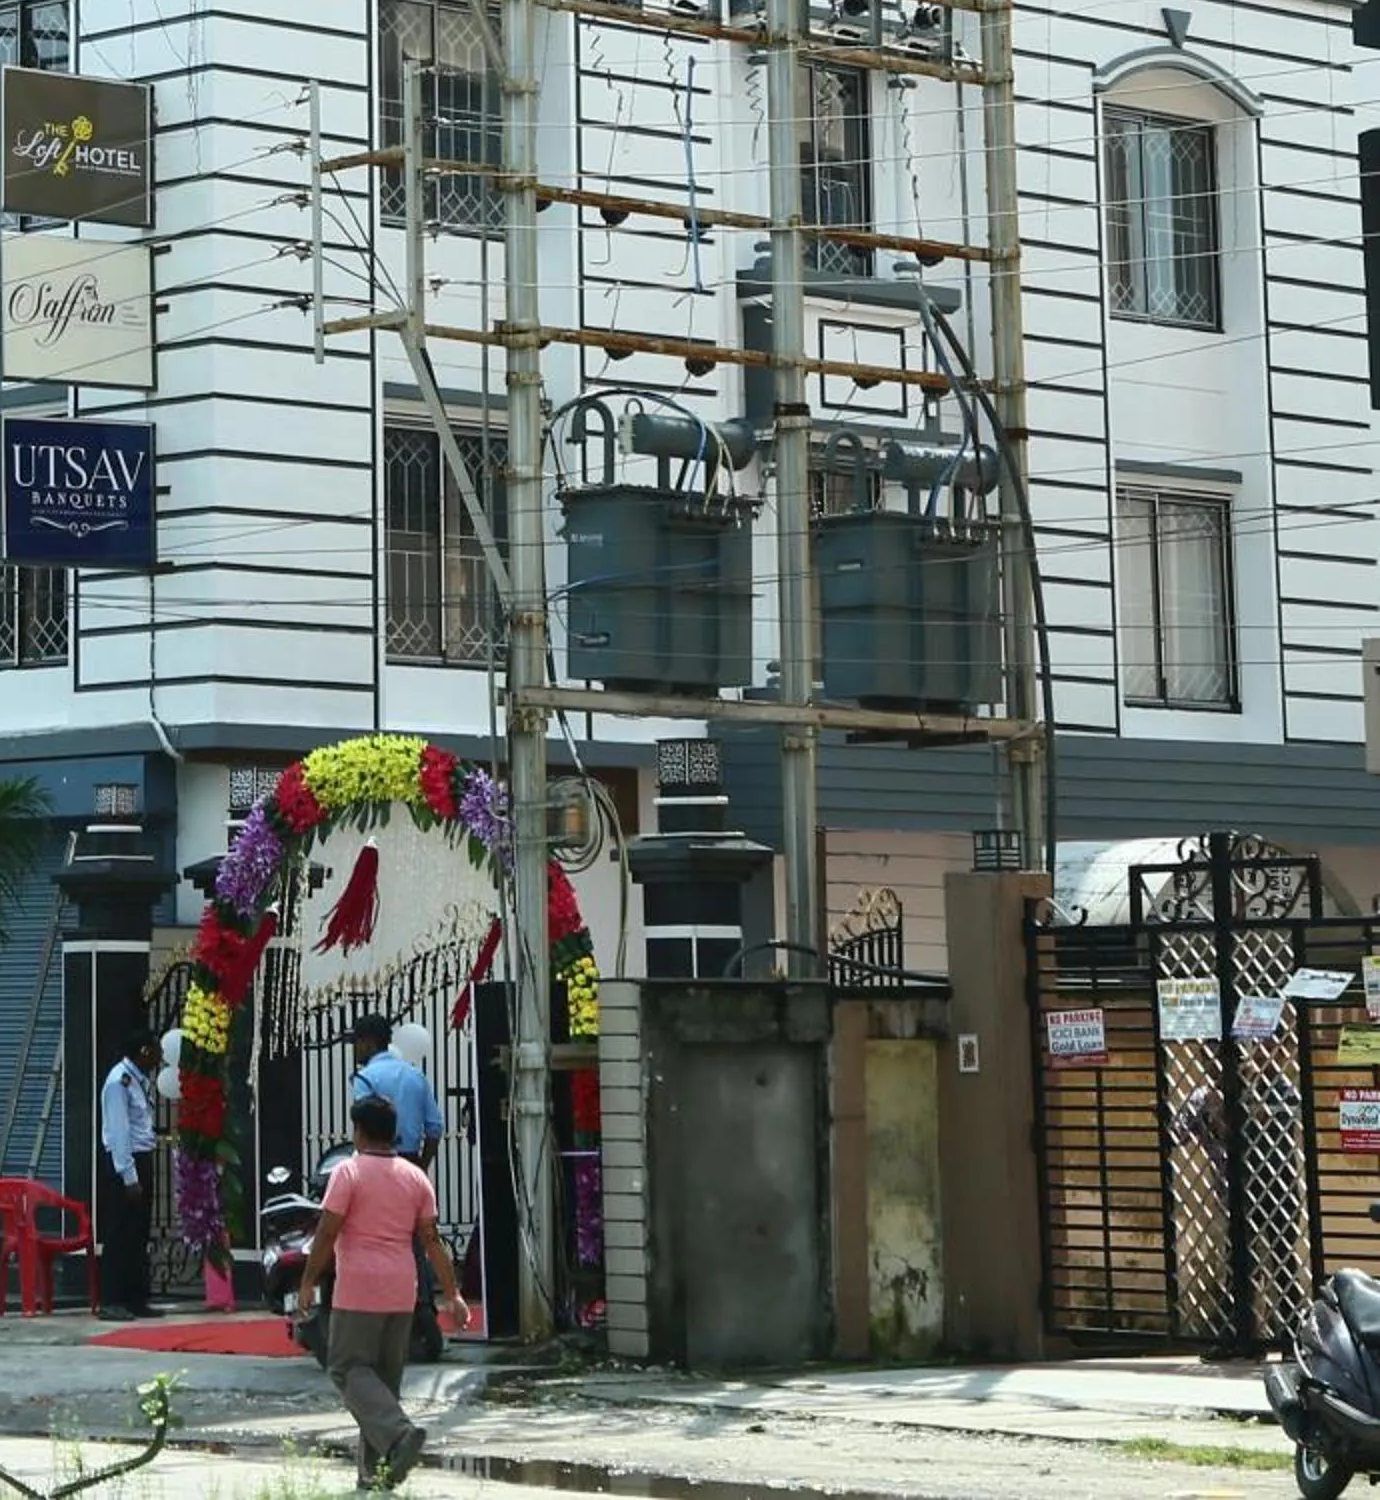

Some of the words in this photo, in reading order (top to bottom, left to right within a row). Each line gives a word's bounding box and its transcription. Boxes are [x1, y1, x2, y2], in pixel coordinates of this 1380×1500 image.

[44, 122, 69, 137] THE
[11, 129, 63, 167] Loft
[75, 145, 141, 170] HOTEL
[8, 273, 115, 348] Saffron
[12, 443, 146, 493] UTSAV
[31, 491, 128, 509] BANQUETS
[1050, 1014, 1061, 1025] NO
[1063, 1011, 1101, 1023] PARKING
[1074, 1026, 1101, 1039] BANK
[1051, 1040, 1075, 1052] Gold
[1343, 1089, 1358, 1100] NO
